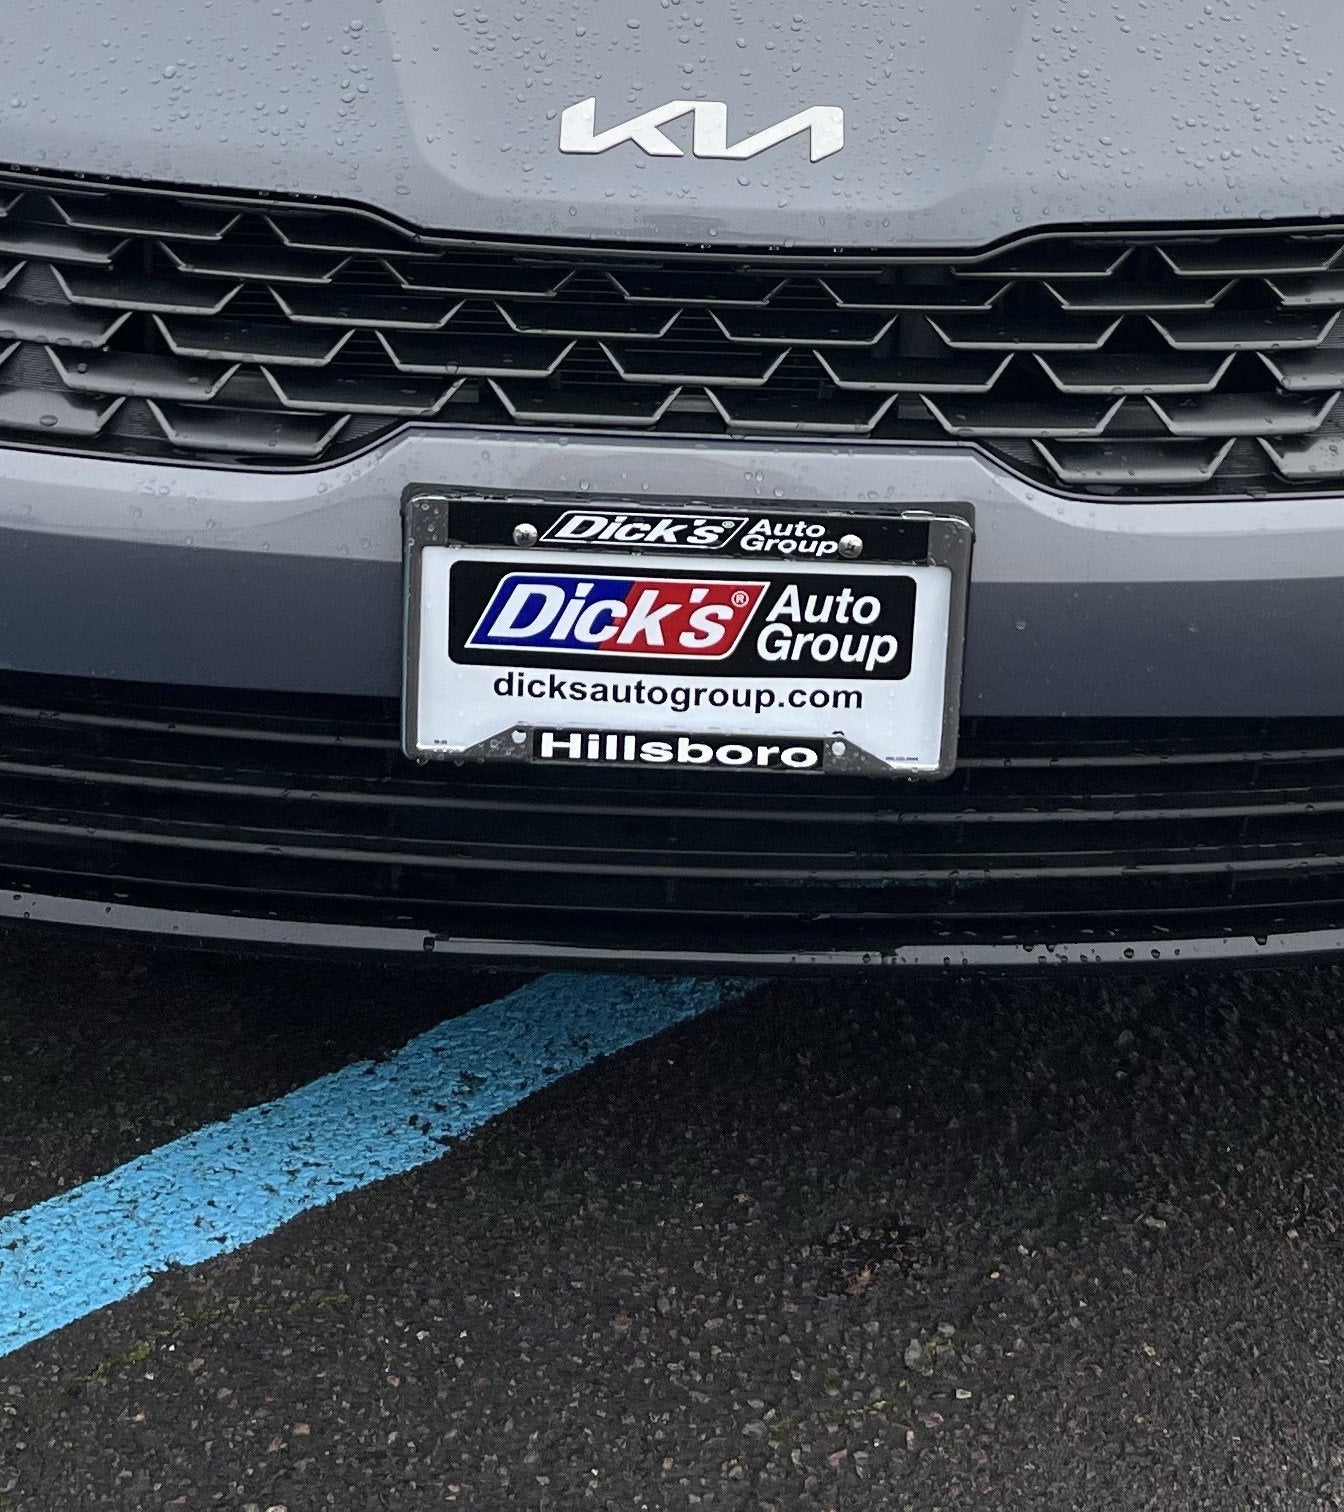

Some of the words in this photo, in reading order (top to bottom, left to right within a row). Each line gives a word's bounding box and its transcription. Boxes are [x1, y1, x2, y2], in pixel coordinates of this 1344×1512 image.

[555, 515, 726, 545] Dick's
[740, 534, 839, 557] Group
[748, 519, 826, 538] Auto
[487, 581, 734, 649] Dick's
[766, 584, 882, 625] Auto
[757, 622, 899, 671] Group
[493, 671, 863, 714] dicksautogroup.com
[541, 732, 819, 768] Hillsboro
